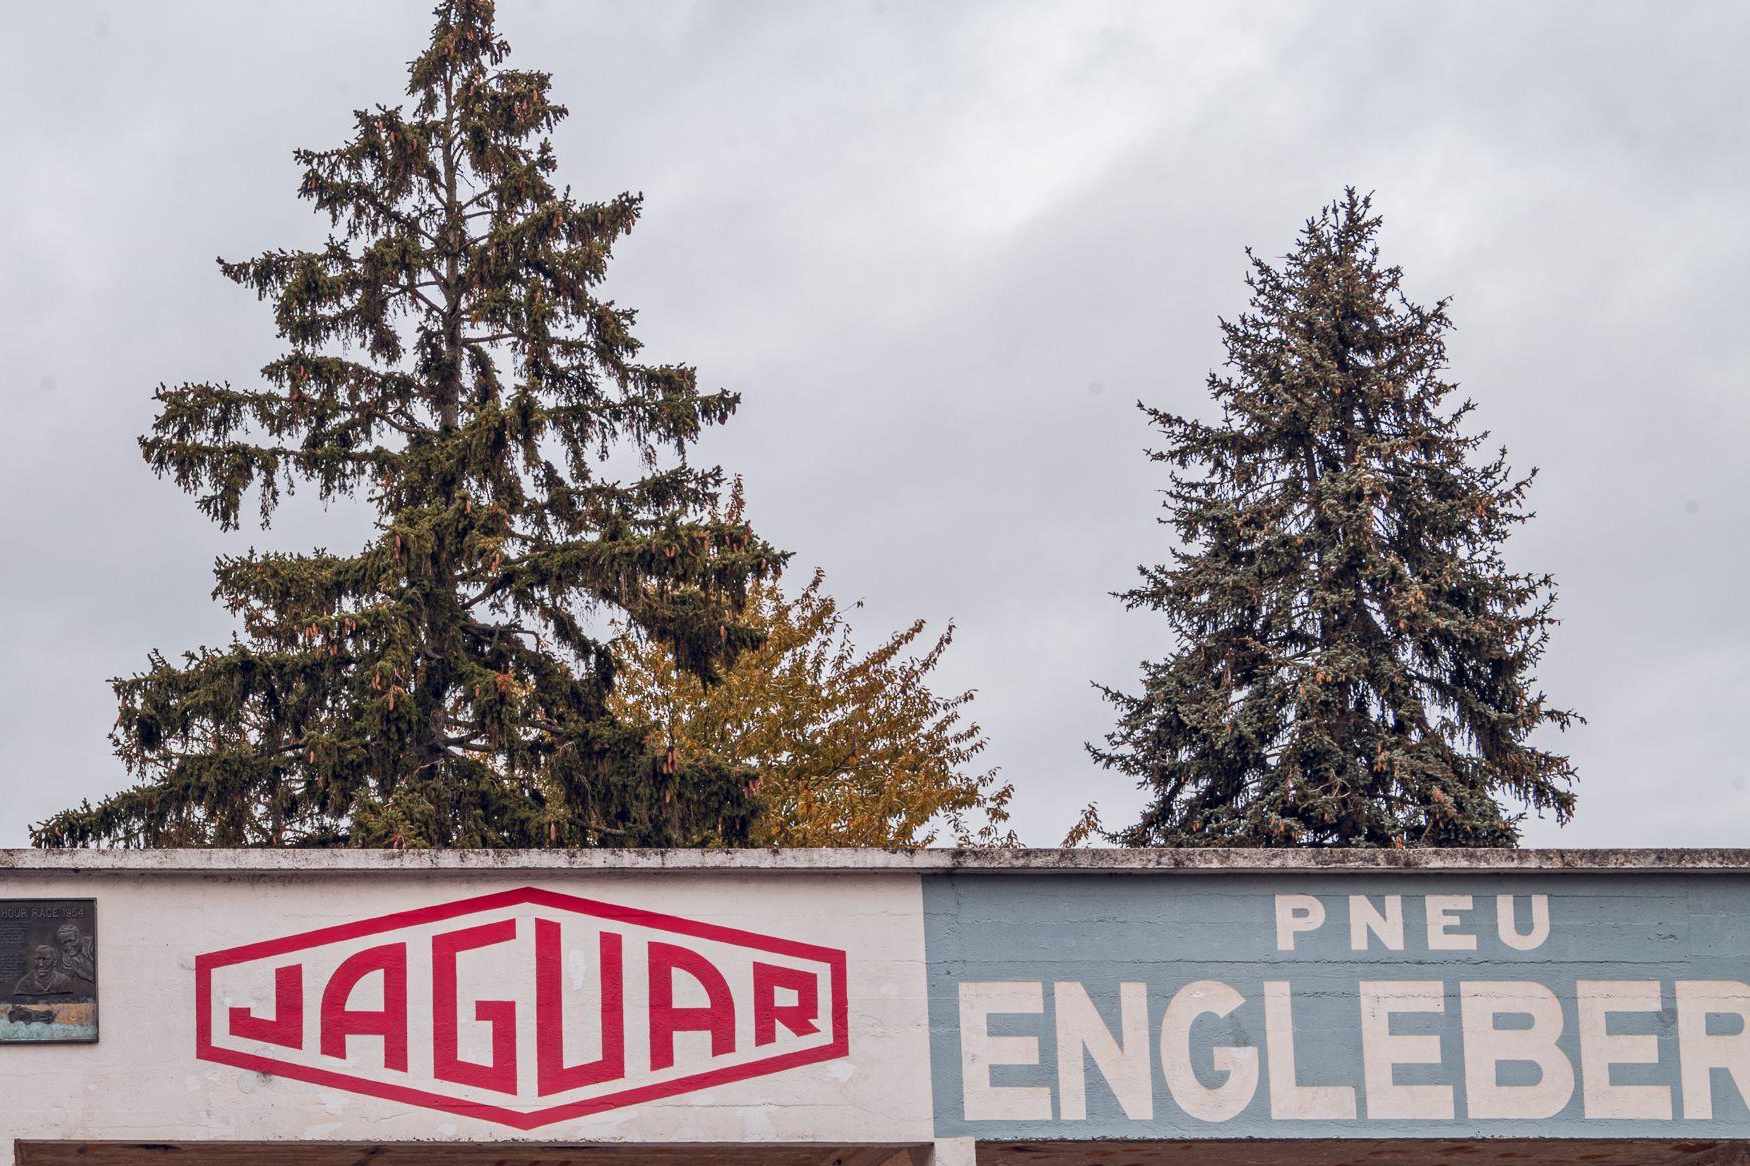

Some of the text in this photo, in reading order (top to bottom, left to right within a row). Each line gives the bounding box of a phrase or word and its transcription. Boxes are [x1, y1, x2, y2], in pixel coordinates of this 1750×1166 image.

[2, 908, 27, 918] HOUR
[32, 908, 59, 918] RACE
[1275, 894, 1550, 951] PNEU
[229, 918, 819, 1097] JAGUAR
[959, 980, 1750, 1122] ENGLEBER
